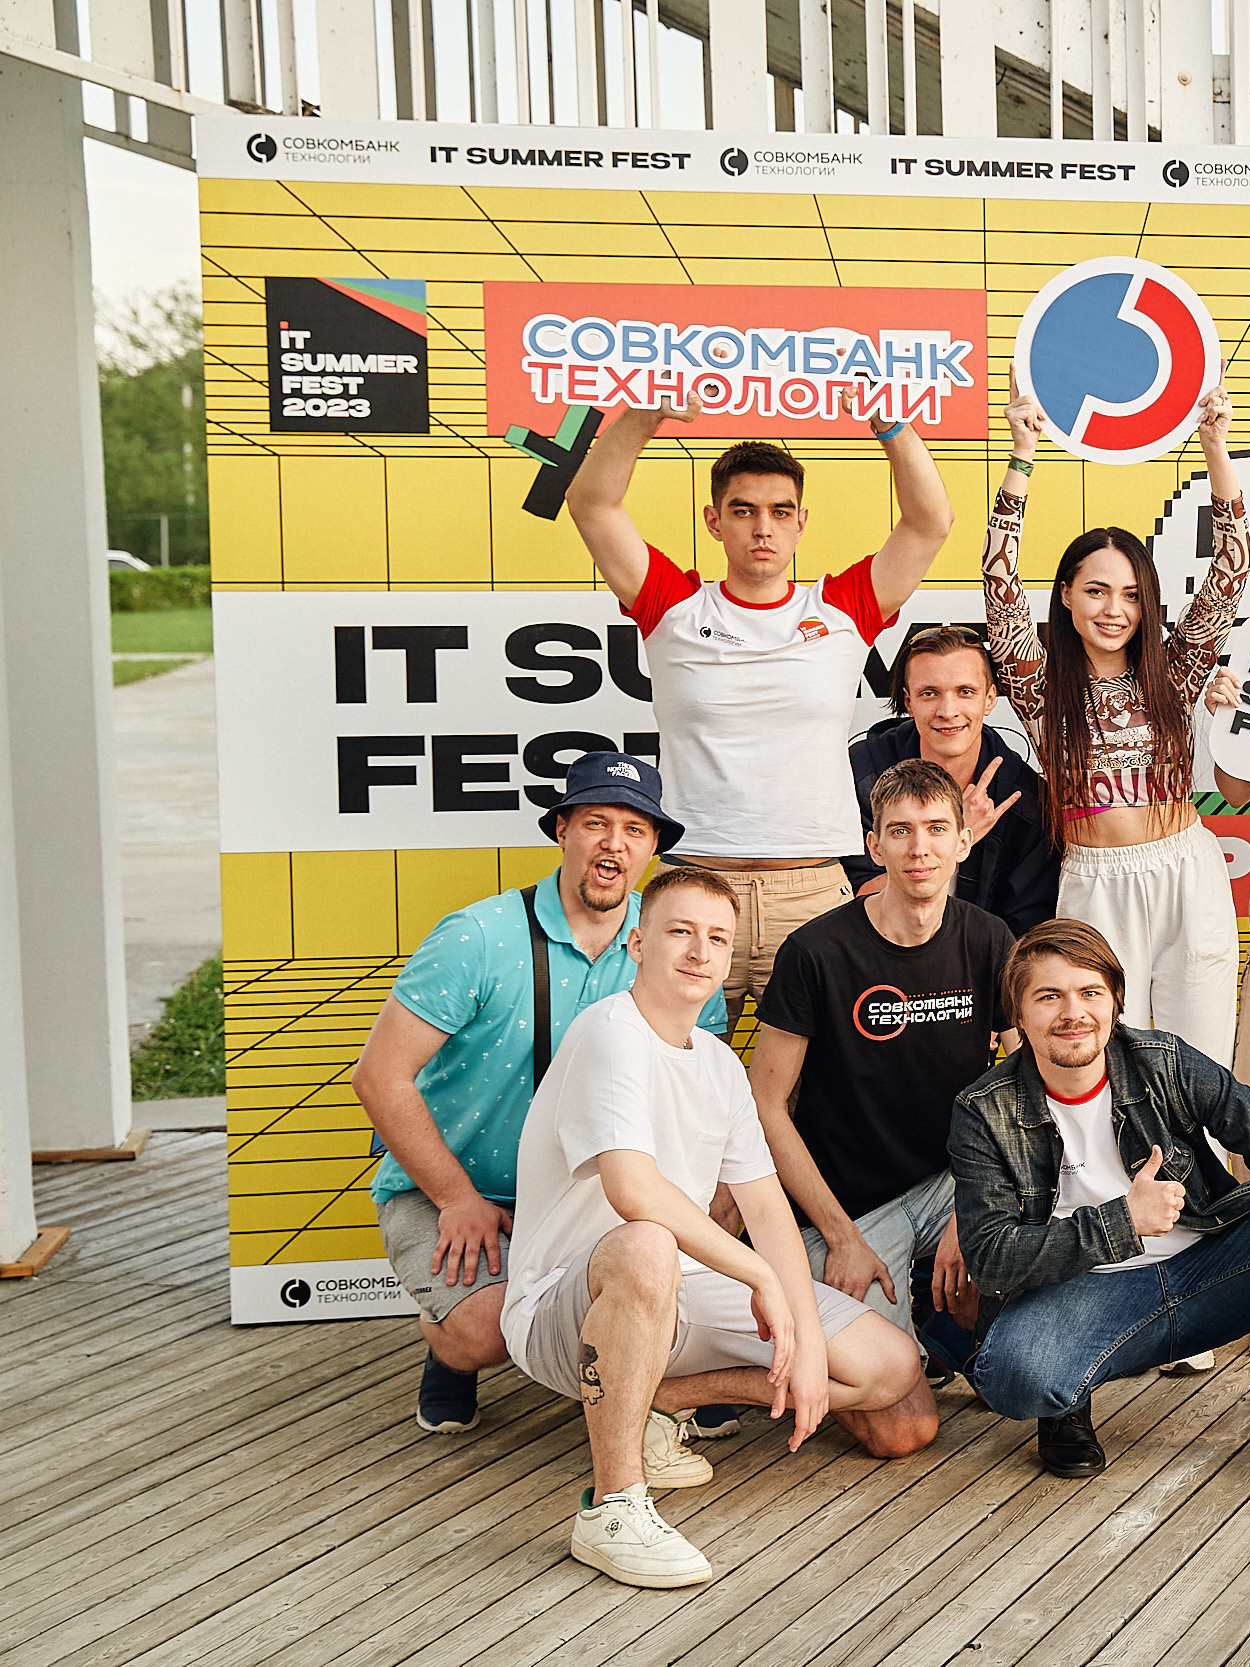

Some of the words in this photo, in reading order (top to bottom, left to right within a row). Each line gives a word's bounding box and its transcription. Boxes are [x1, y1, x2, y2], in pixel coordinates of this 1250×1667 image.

[283, 137, 400, 152] СОВКОМБАНК
[285, 152, 371, 164] ТЕХНОЛОГИИ
[431, 146, 459, 163] IT
[467, 147, 604, 168] SUMMER
[612, 151, 691, 170] FEST
[754, 151, 862, 165] СОВКОМБАНК
[755, 165, 835, 176] ТЕХНОЛОГИИ
[890, 158, 917, 175] IT
[925, 158, 1054, 179] SUMMER
[1060, 163, 1136, 181] FEST
[528, 318, 968, 382] СОВКОМБАНК
[280, 352, 419, 374] SUMMER
[281, 375, 365, 395] FEST
[527, 360, 936, 421] ТЕХНОЛОГИИ
[282, 397, 371, 418] 2023
[335, 626, 468, 704] IT
[868, 994, 974, 1014] СОВКОМБАНК
[867, 1007, 973, 1026] ТЕХНОЛОГИИ
[316, 1276, 401, 1292] СОВКОМБ
[317, 1290, 401, 1304] ТЕХНОЛОГИИ
